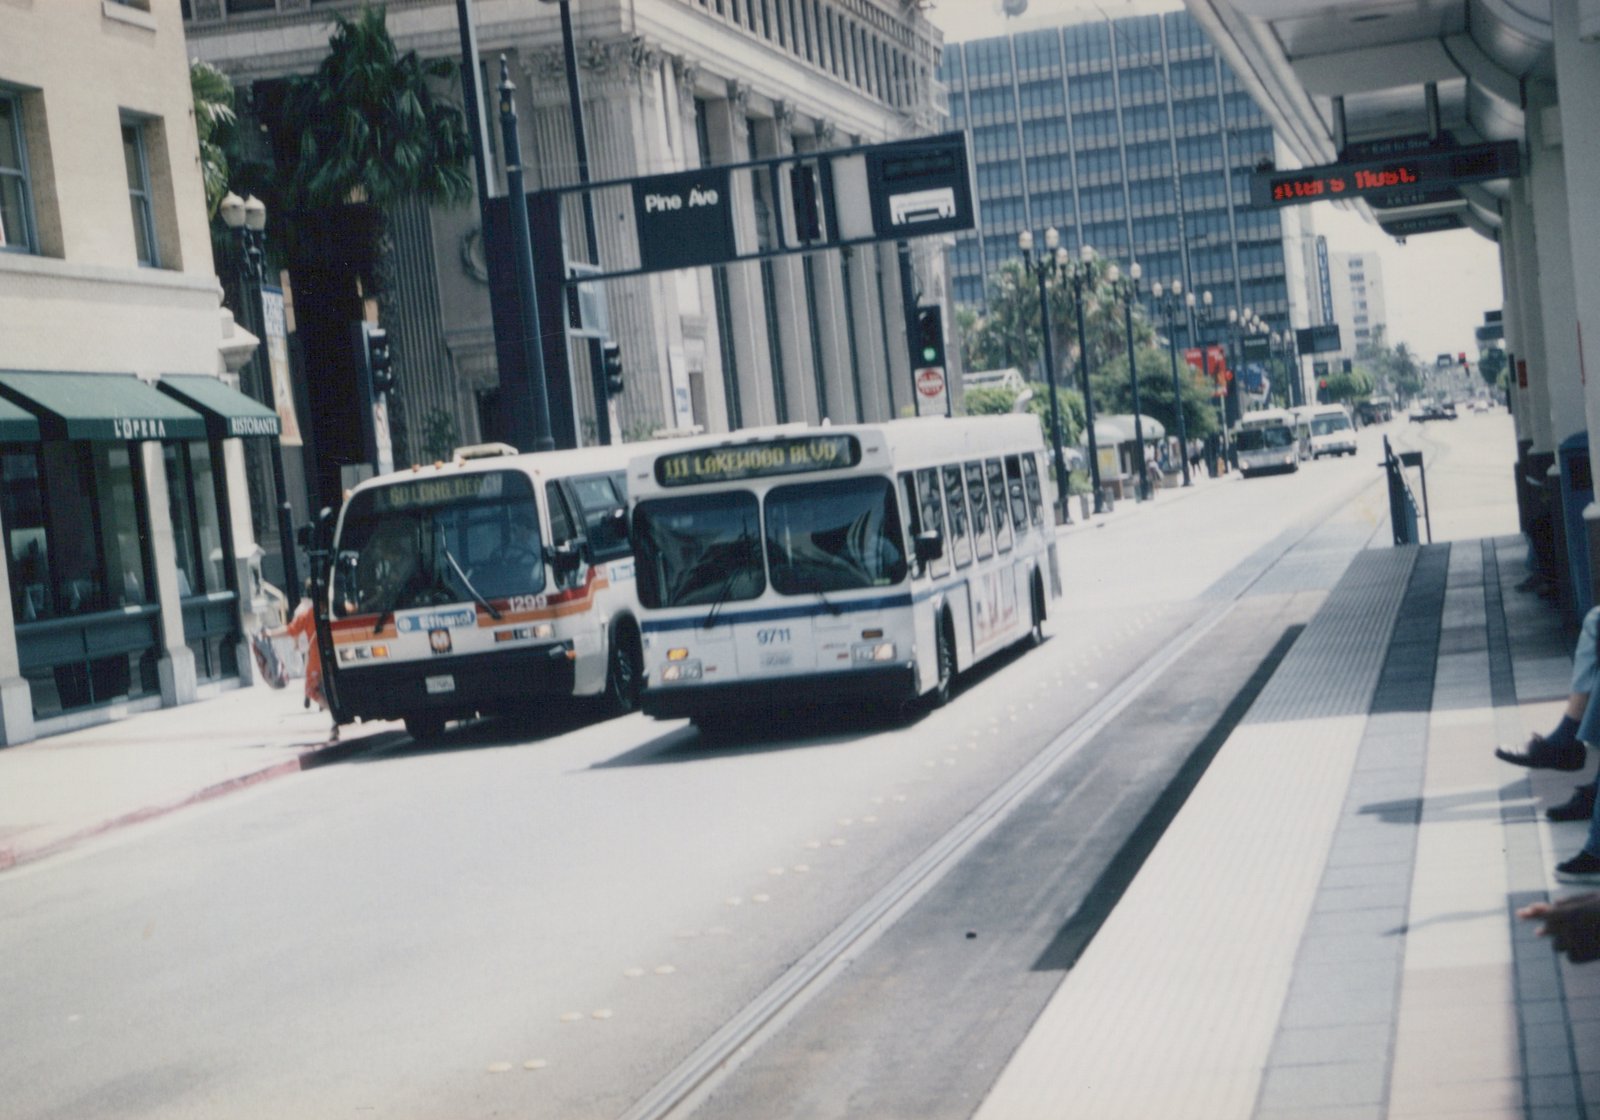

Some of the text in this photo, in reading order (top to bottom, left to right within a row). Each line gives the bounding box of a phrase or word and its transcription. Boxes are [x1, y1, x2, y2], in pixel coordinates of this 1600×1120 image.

[645, 188, 719, 213] Pine Ave
[231, 416, 279, 435] RISTORANTE
[665, 440, 838, 479] 111 LAKEWOOD BLVD
[509, 595, 548, 613] 1299
[418, 610, 472, 630] Ethanol
[756, 627, 791, 645] 9711
